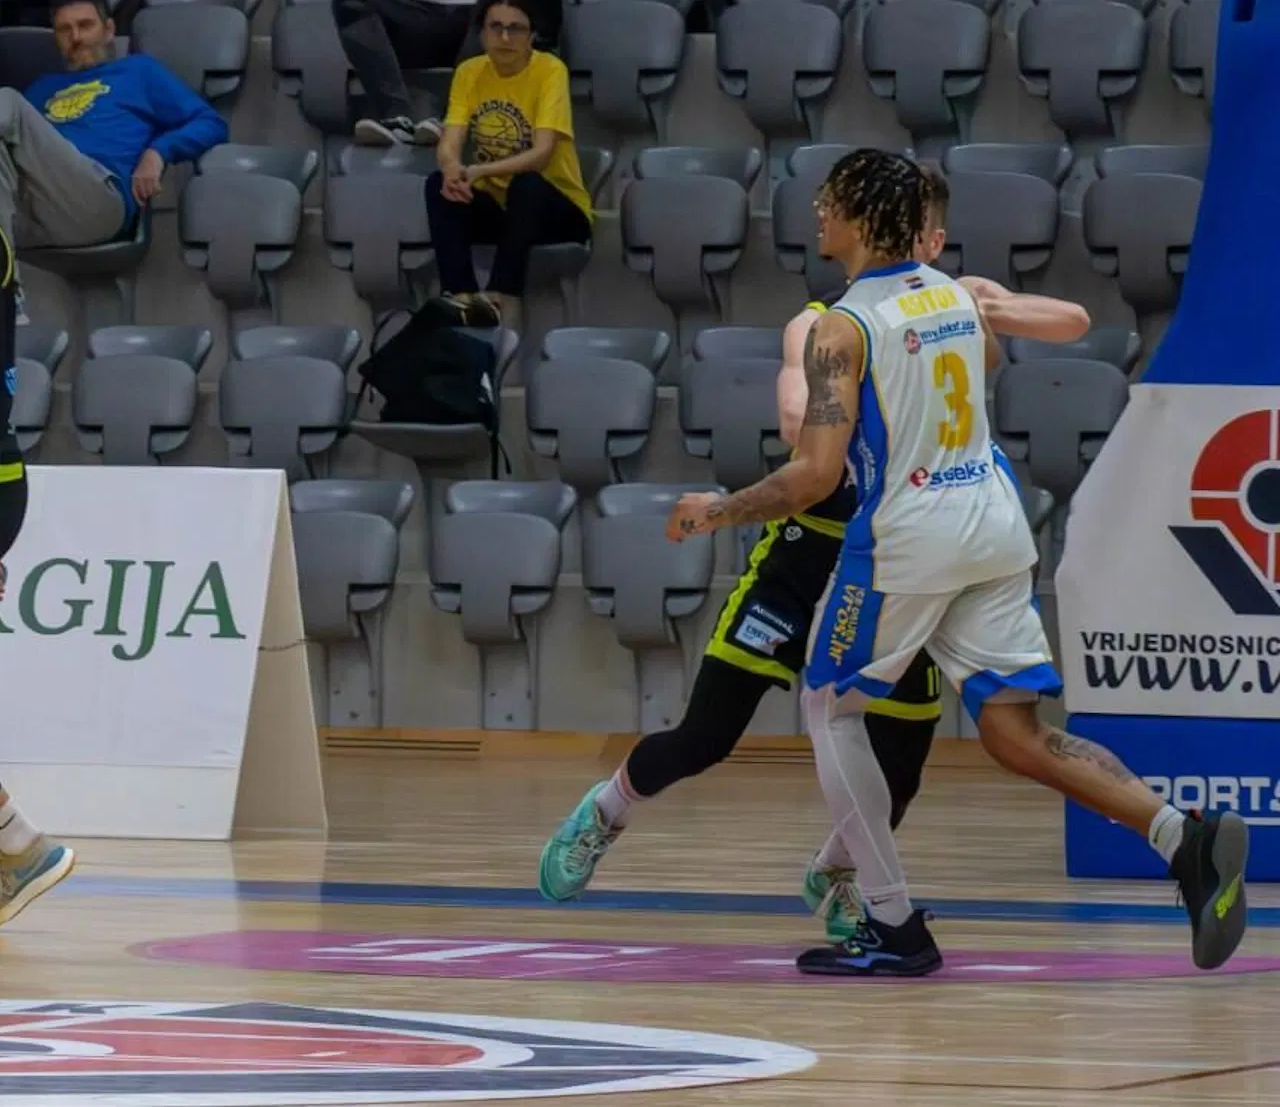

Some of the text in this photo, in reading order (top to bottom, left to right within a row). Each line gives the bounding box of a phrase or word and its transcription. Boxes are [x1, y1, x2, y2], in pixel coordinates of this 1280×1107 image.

[932, 351, 972, 451] 3
[1080, 630, 1280, 656] VRIJEDNOSNIC
[1140, 775, 1280, 811] PORT
